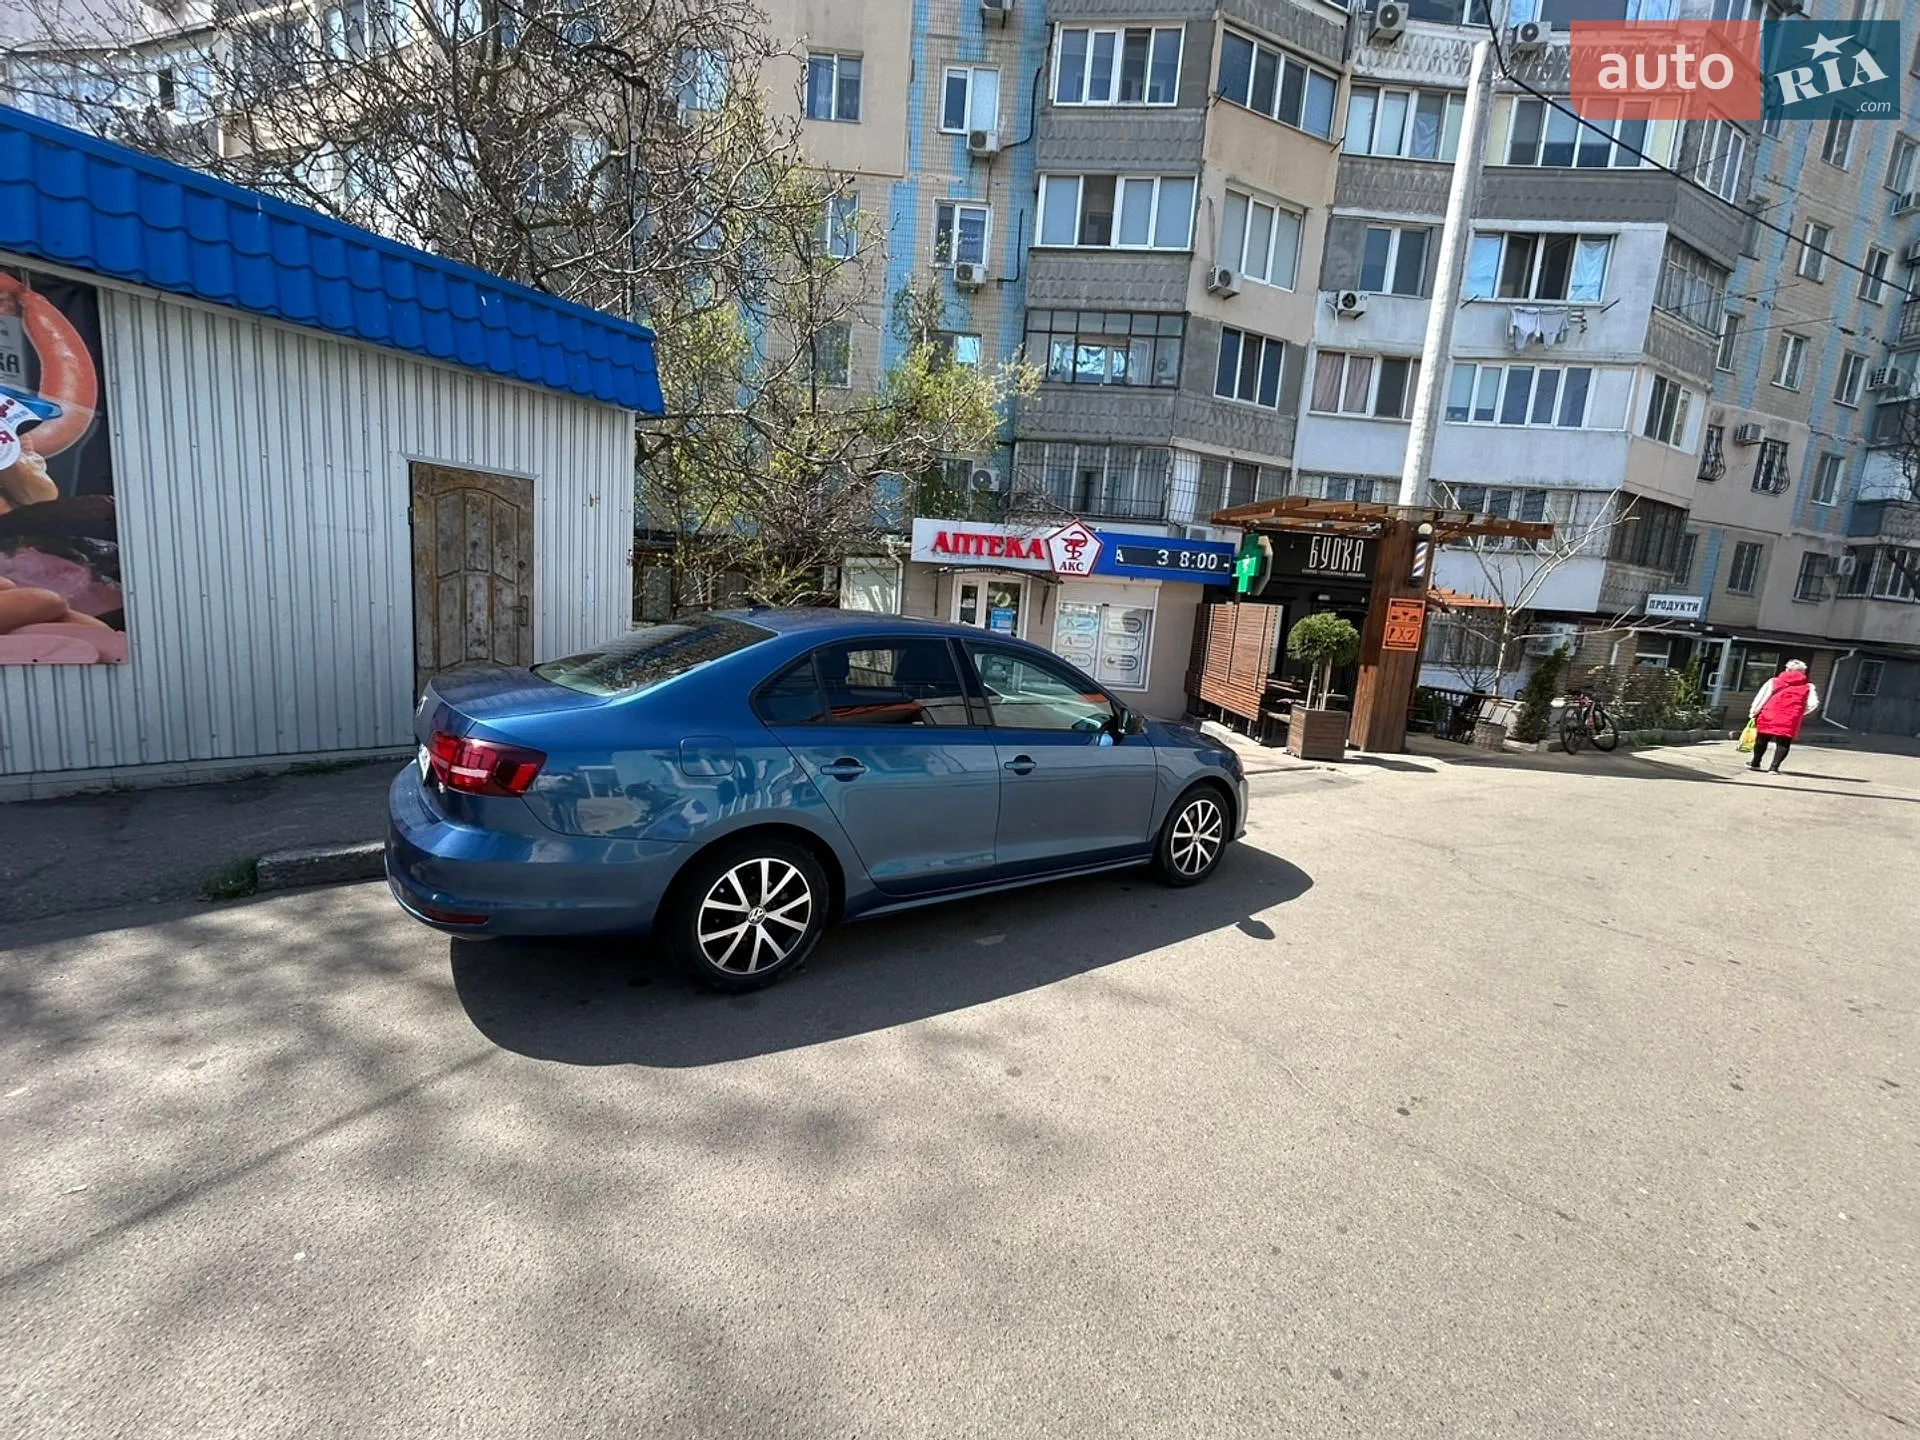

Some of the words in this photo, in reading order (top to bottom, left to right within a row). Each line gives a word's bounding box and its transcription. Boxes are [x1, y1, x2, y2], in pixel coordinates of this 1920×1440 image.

[931, 531, 1045, 560] АПТЕКА
[1058, 561, 1084, 572] АКС
[1179, 551, 1218, 570] 8:00
